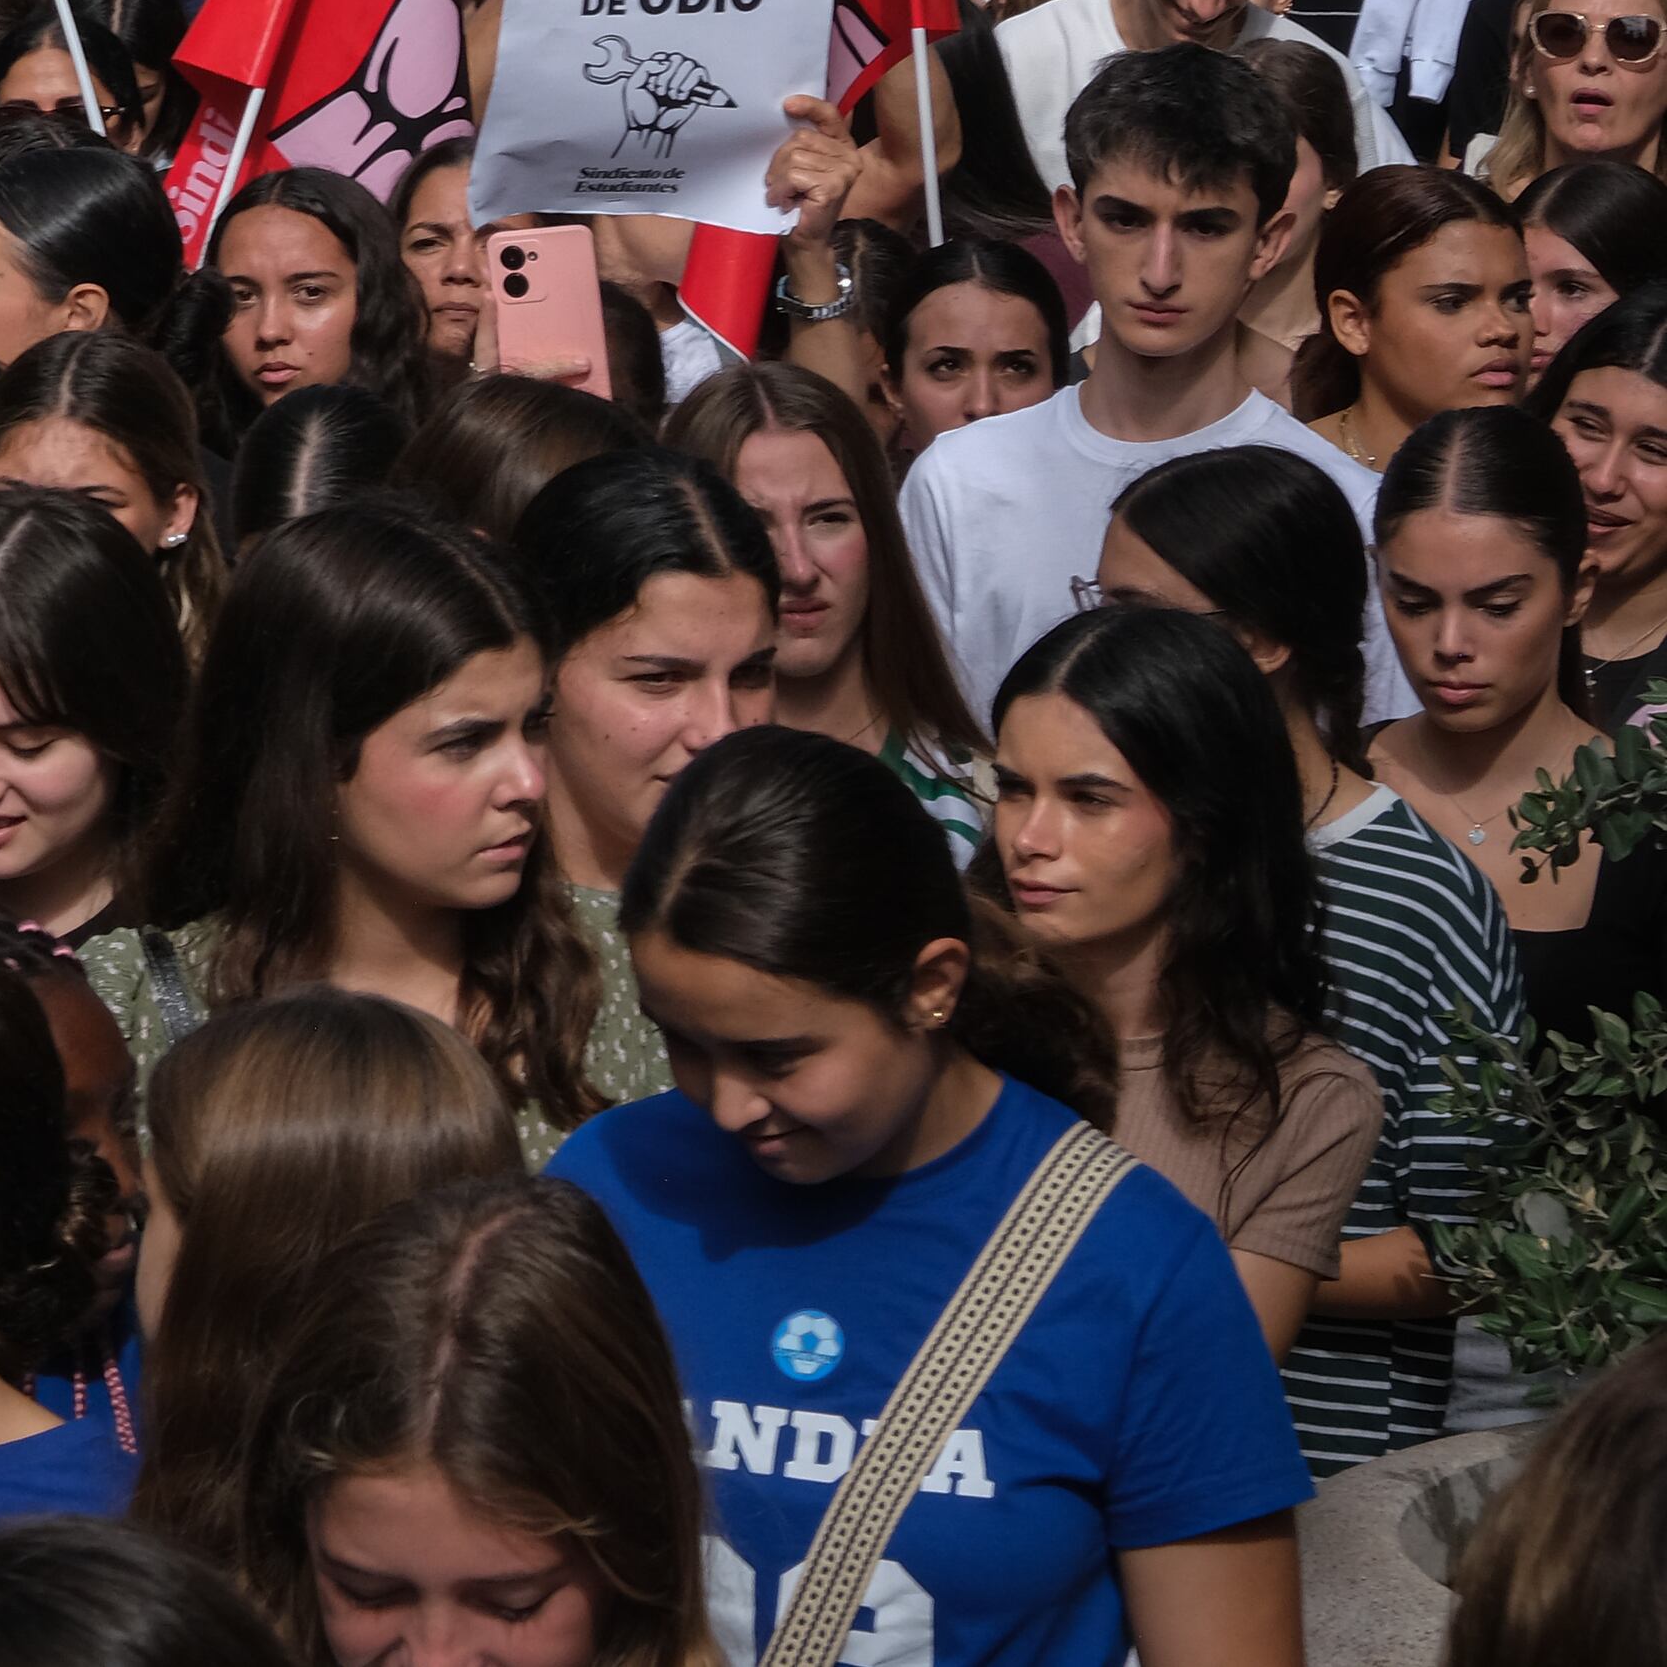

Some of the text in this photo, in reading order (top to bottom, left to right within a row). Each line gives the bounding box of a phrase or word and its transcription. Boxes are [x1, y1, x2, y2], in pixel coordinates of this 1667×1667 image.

[577, 166, 686, 180] Sindicato de
[573, 180, 679, 194] Estudiantes
